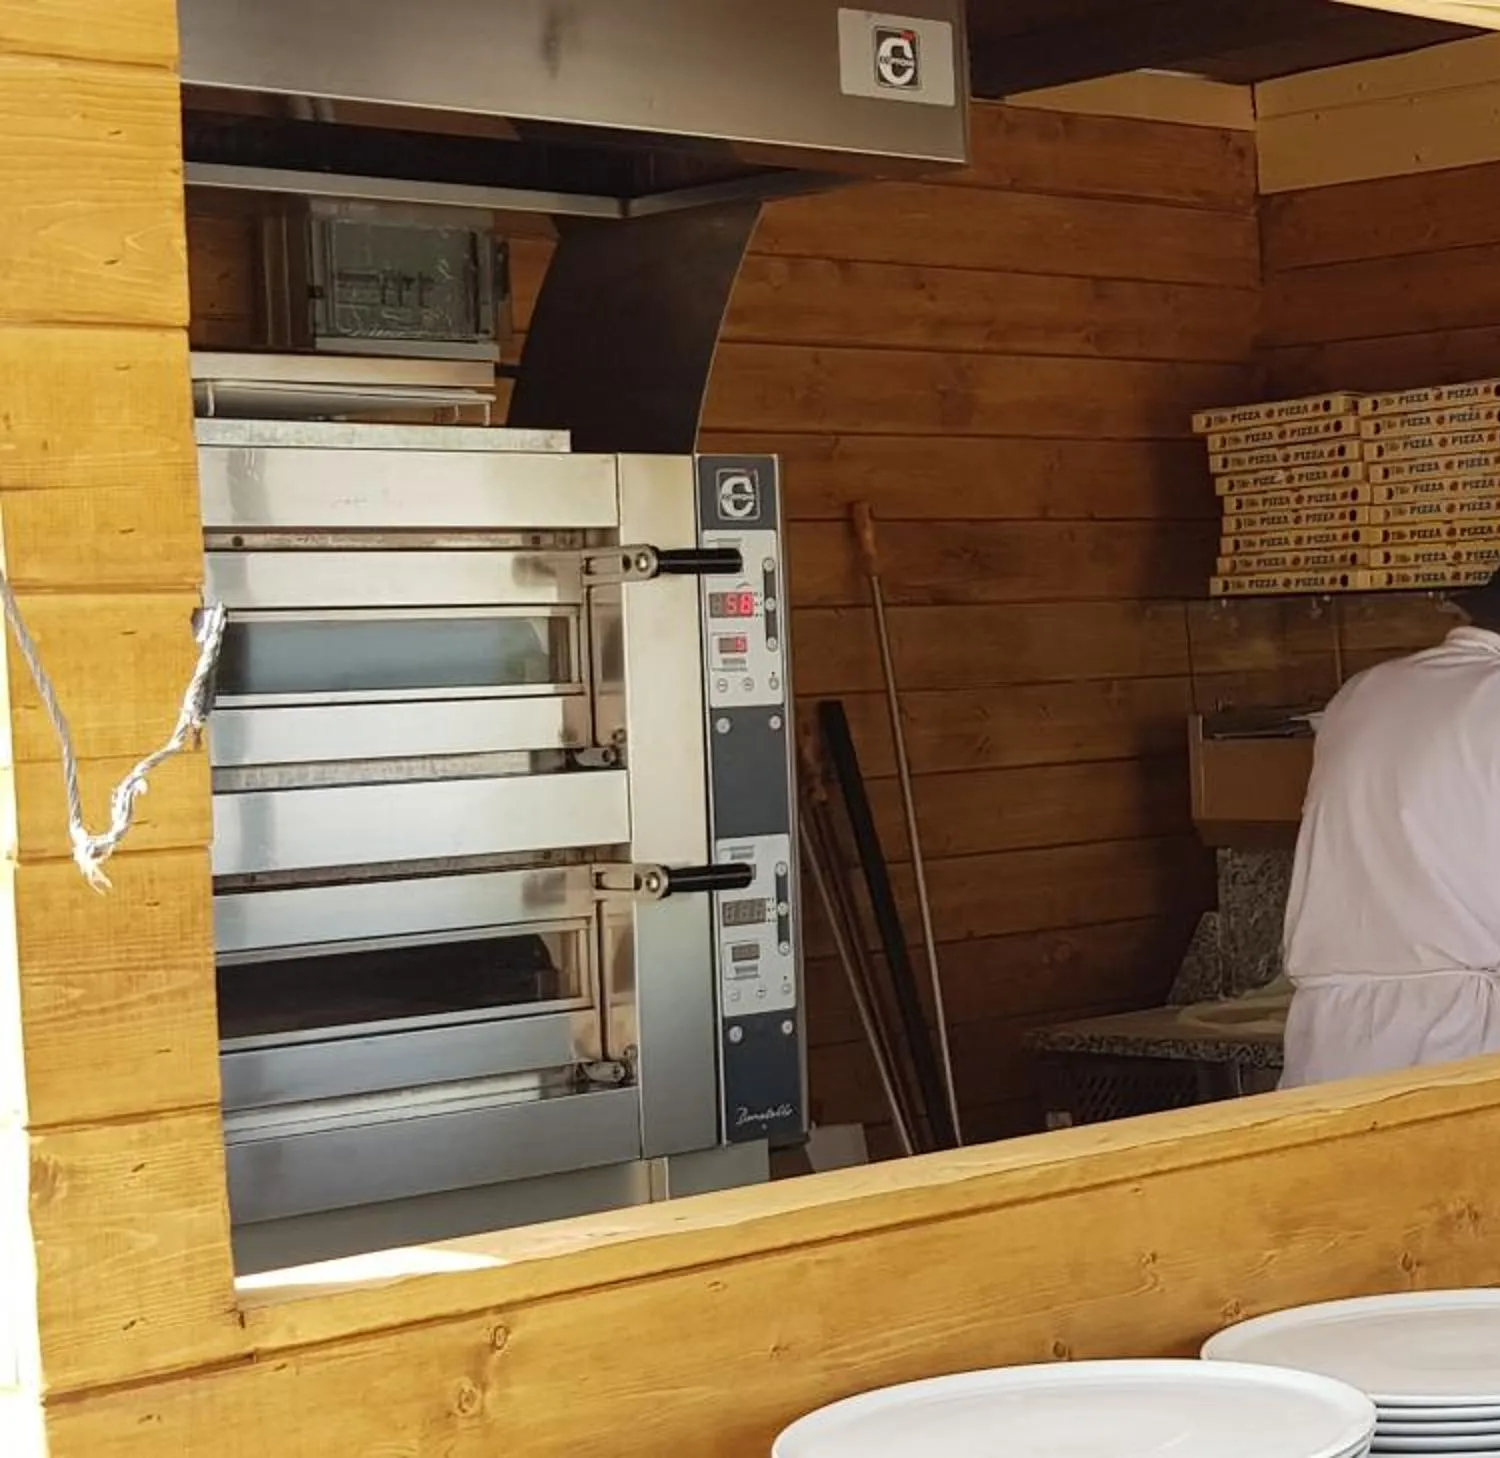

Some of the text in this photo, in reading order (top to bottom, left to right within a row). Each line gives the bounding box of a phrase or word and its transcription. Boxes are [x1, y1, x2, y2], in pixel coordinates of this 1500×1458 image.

[1398, 387, 1479, 403] PIZZA PIZZA
[1231, 405, 1309, 423] PIZZA PIZZA
[1401, 411, 1481, 428] PIZZA PIZZA
[1245, 426, 1320, 443] PIZZA PIZZA
[1403, 433, 1484, 449] PIZZA PIZZA
[1248, 450, 1325, 465] PIZZA PIZZA
[1408, 457, 1490, 474] PIZZA PIZZA
[1298, 470, 1329, 482] PIZZA
[1413, 477, 1495, 493] PIZZA PIZZA
[1262, 492, 1337, 508] PIZZA PIZZA
[1409, 501, 1491, 515] PIZZA PIZZA
[1260, 511, 1335, 526] PIZZA PIZZA
[1260, 532, 1337, 547] PIZZA PIZZA
[1409, 526, 1493, 539] PIZZA PIZZA
[1256, 554, 1335, 568] PIZZA PIZZA
[1414, 552, 1447, 562] PIZZA
[1248, 575, 1325, 589] PIZZA PIZZA
[1414, 571, 1491, 582] PIZZA PIZZ
